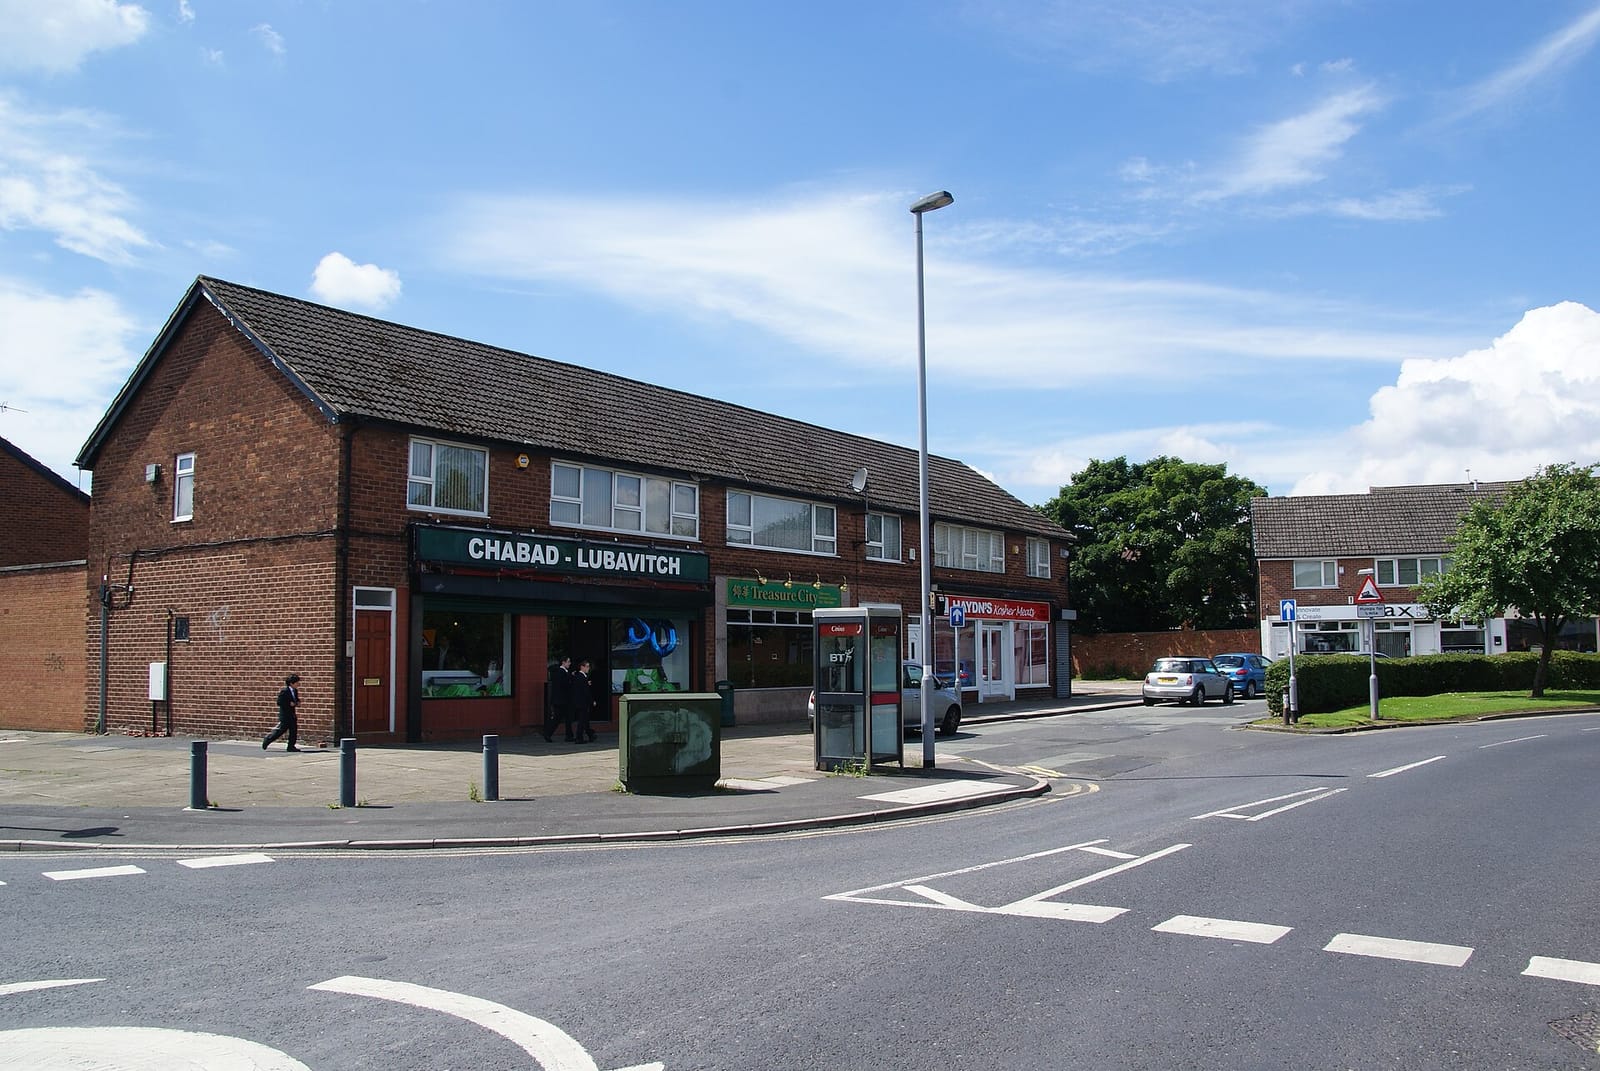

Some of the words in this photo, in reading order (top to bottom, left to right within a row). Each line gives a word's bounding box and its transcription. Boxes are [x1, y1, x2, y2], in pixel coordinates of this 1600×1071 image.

[468, 537, 560, 565] CHABAD
[577, 548, 681, 575] LUBAVITCH
[751, 586, 796, 602] Treasure
[797, 589, 817, 604] City
[993, 604, 1016, 616] Kosher
[829, 653, 845, 662] BT
